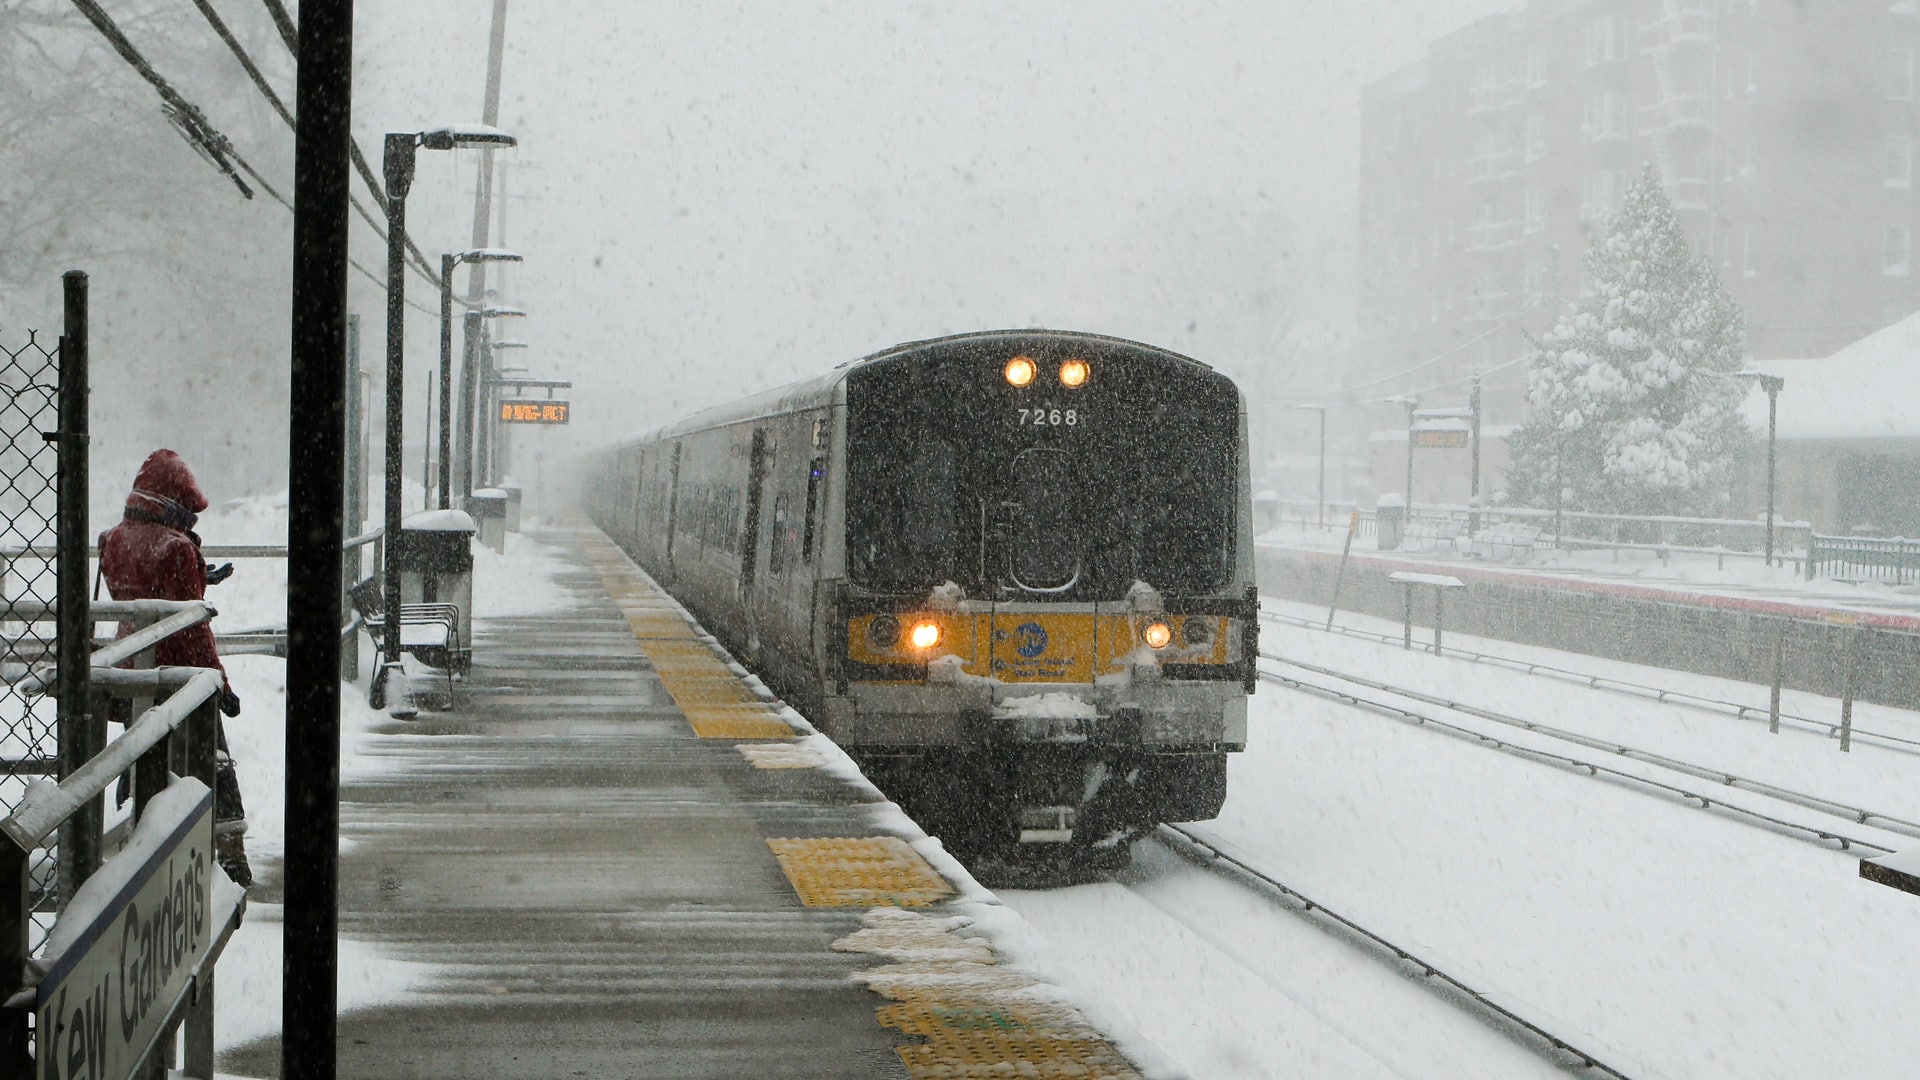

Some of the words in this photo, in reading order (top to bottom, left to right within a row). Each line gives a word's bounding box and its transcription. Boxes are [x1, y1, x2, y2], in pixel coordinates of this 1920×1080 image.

[1018, 408, 1077, 426] 7268
[44, 972, 110, 1080] Kew
[120, 851, 204, 1044] Gardens
